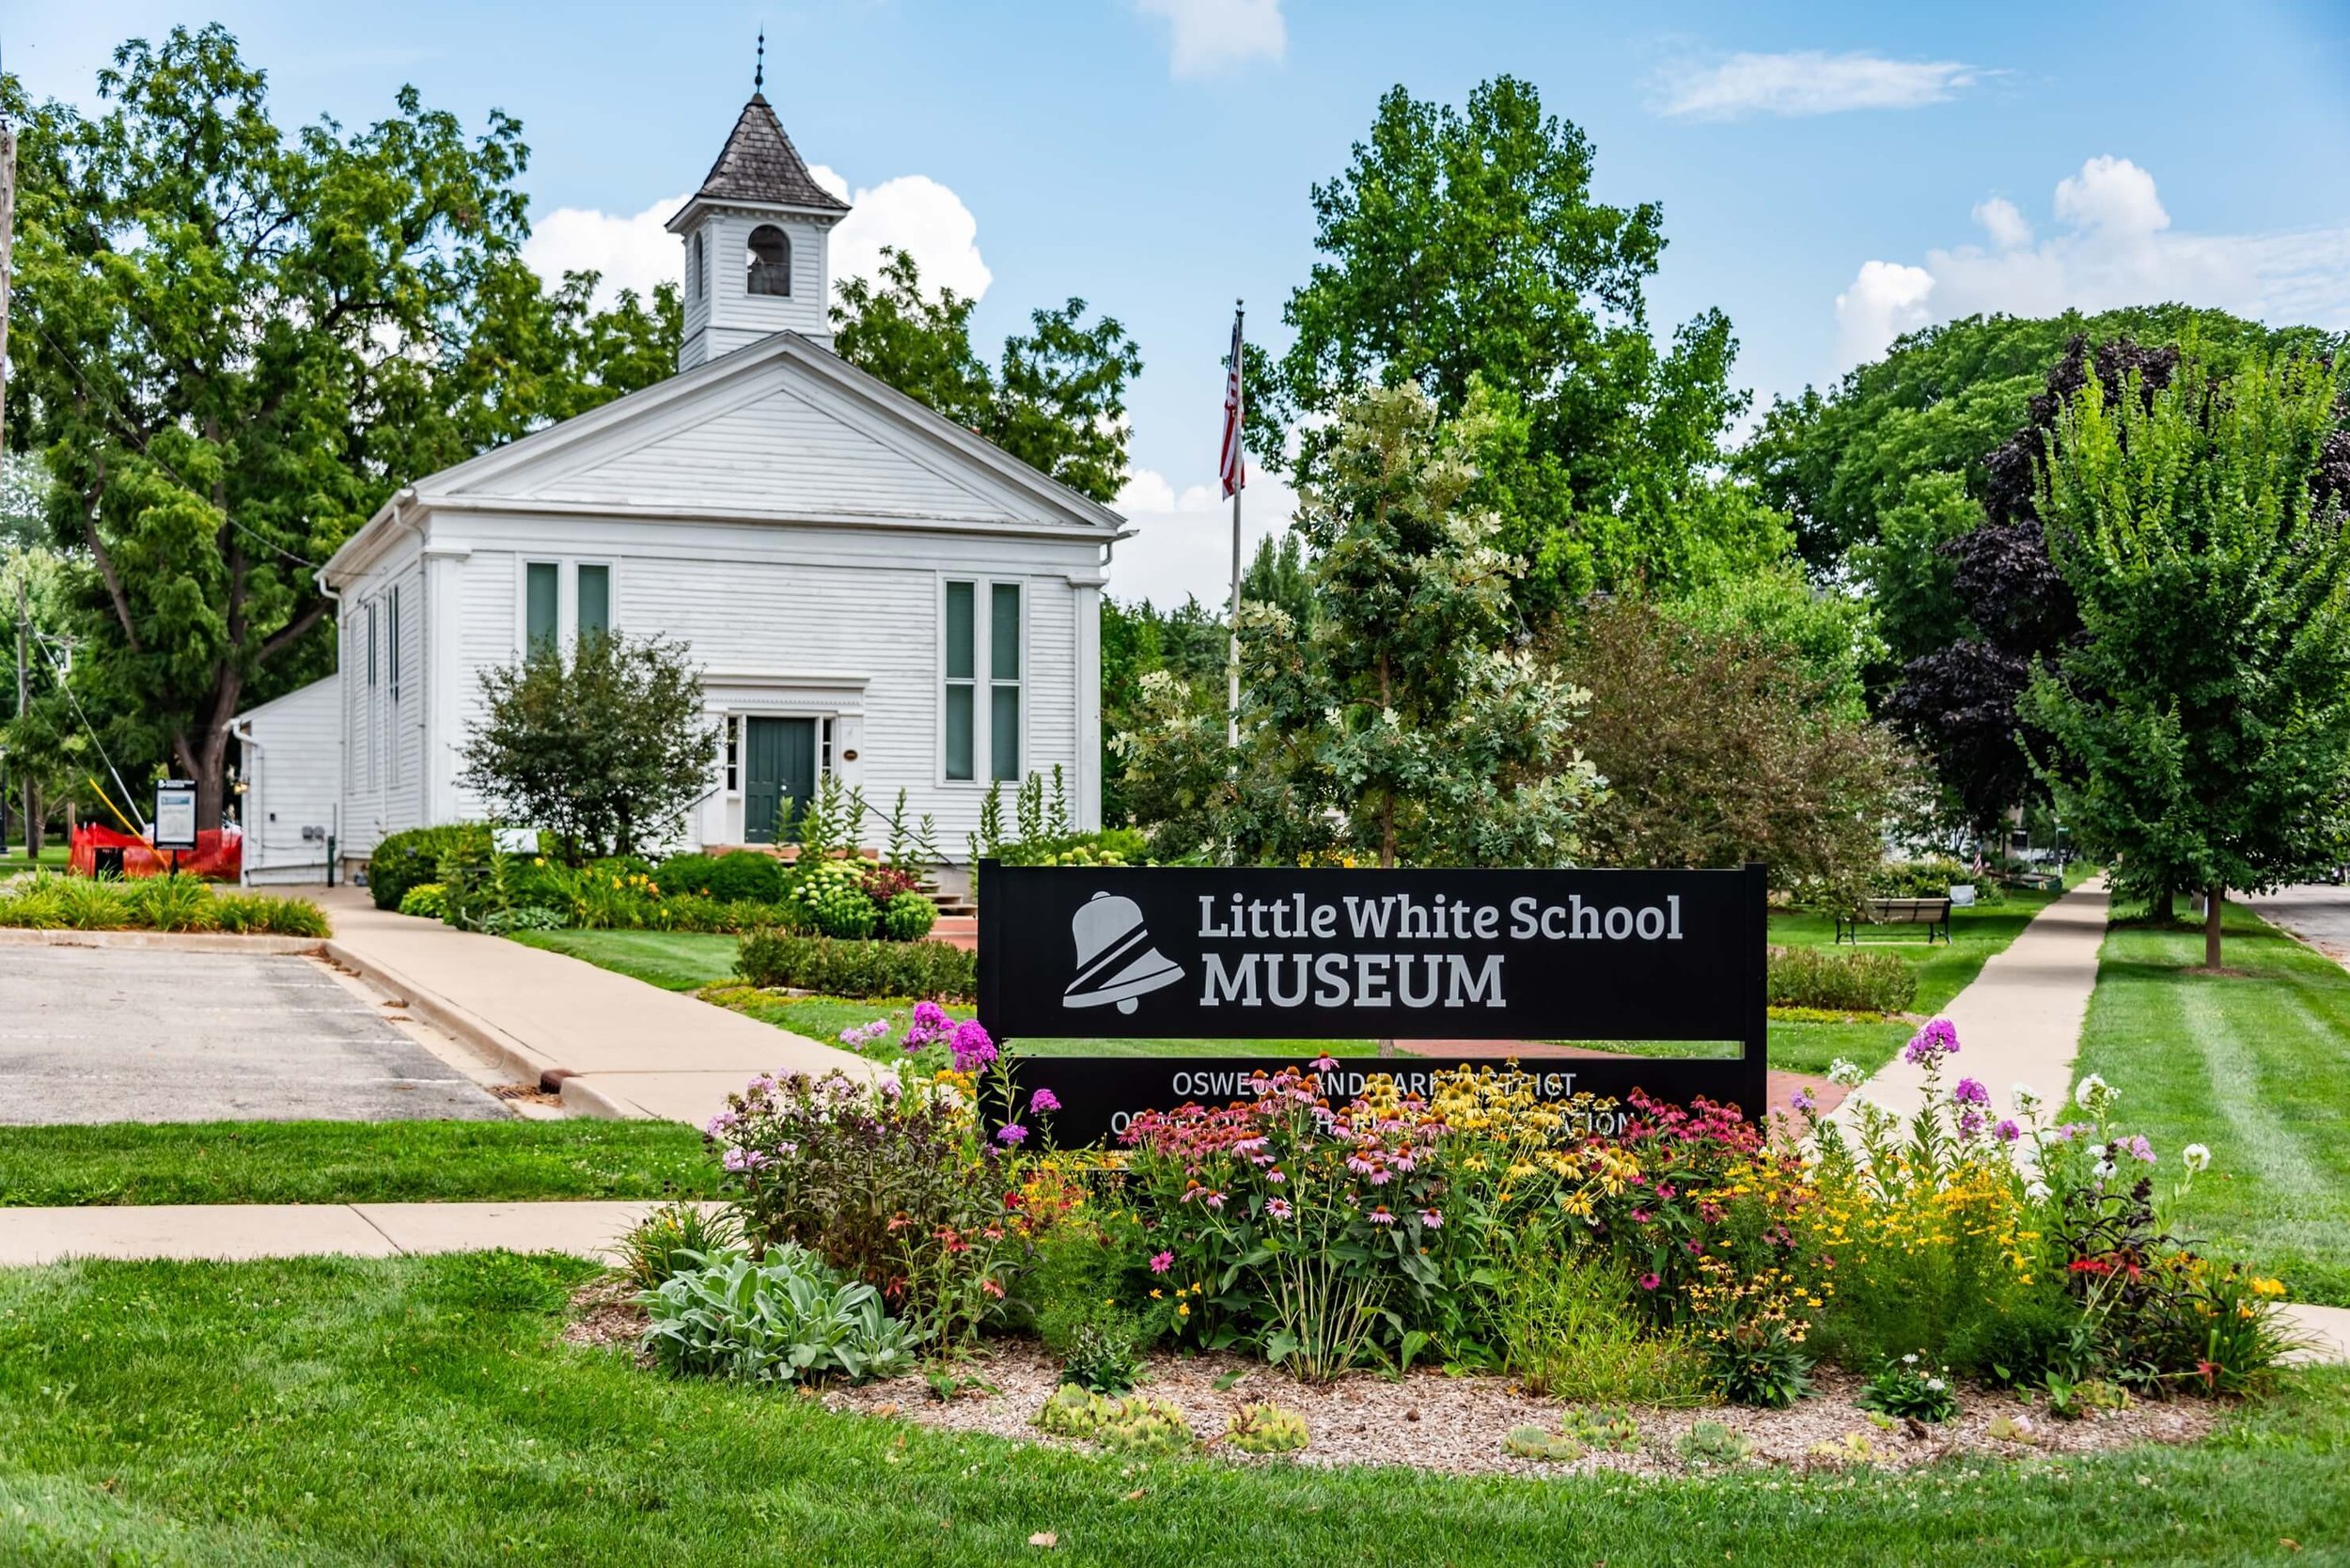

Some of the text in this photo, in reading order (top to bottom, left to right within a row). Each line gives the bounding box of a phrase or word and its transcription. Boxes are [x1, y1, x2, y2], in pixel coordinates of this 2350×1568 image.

[1198, 893, 1684, 940] Little White School
[1199, 952, 1507, 1008] MUSEUM
[1172, 1072, 1577, 1096] OSWEAND AR TICT
